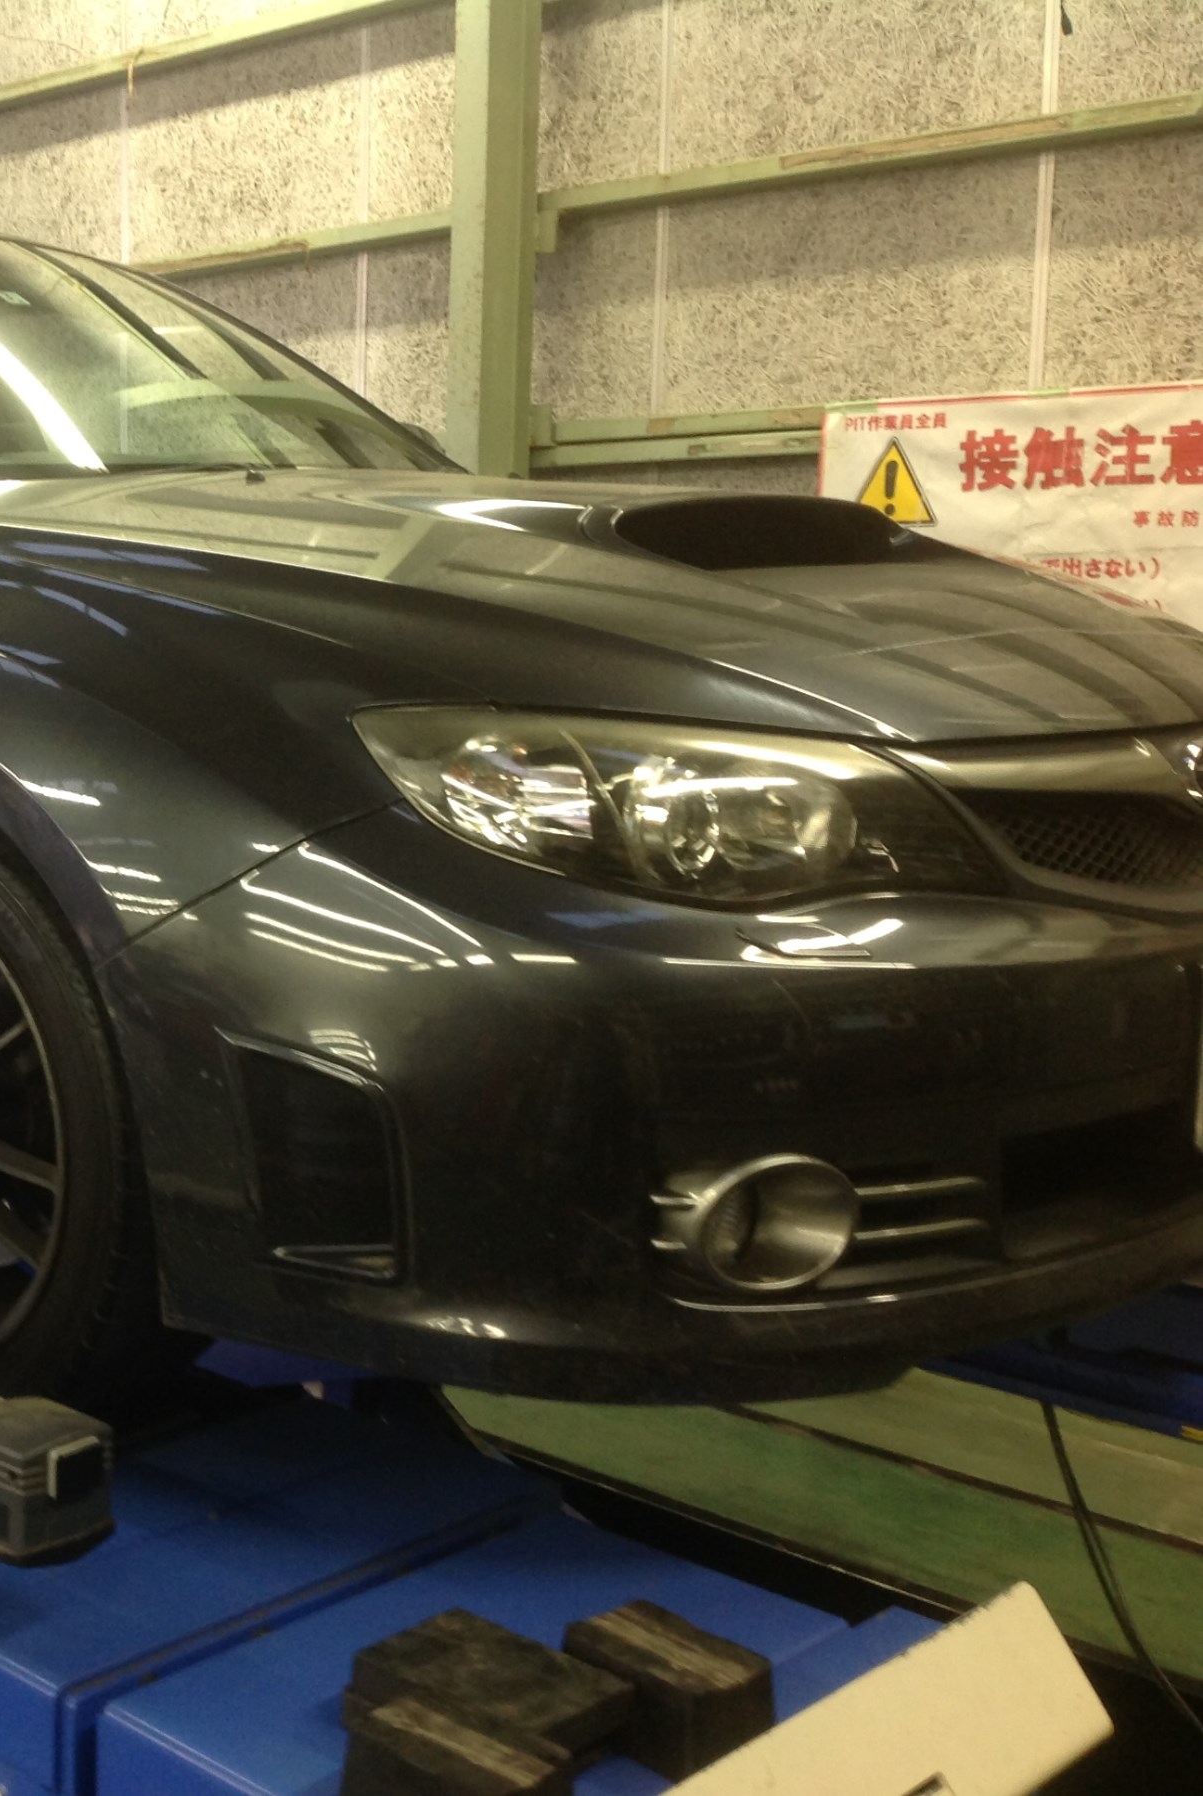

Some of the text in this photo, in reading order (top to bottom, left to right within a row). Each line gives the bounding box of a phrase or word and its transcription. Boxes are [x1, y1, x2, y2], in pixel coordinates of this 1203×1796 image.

[845, 412, 947, 431] PIT作業員全員
[960, 420, 1203, 491] 接触注意
